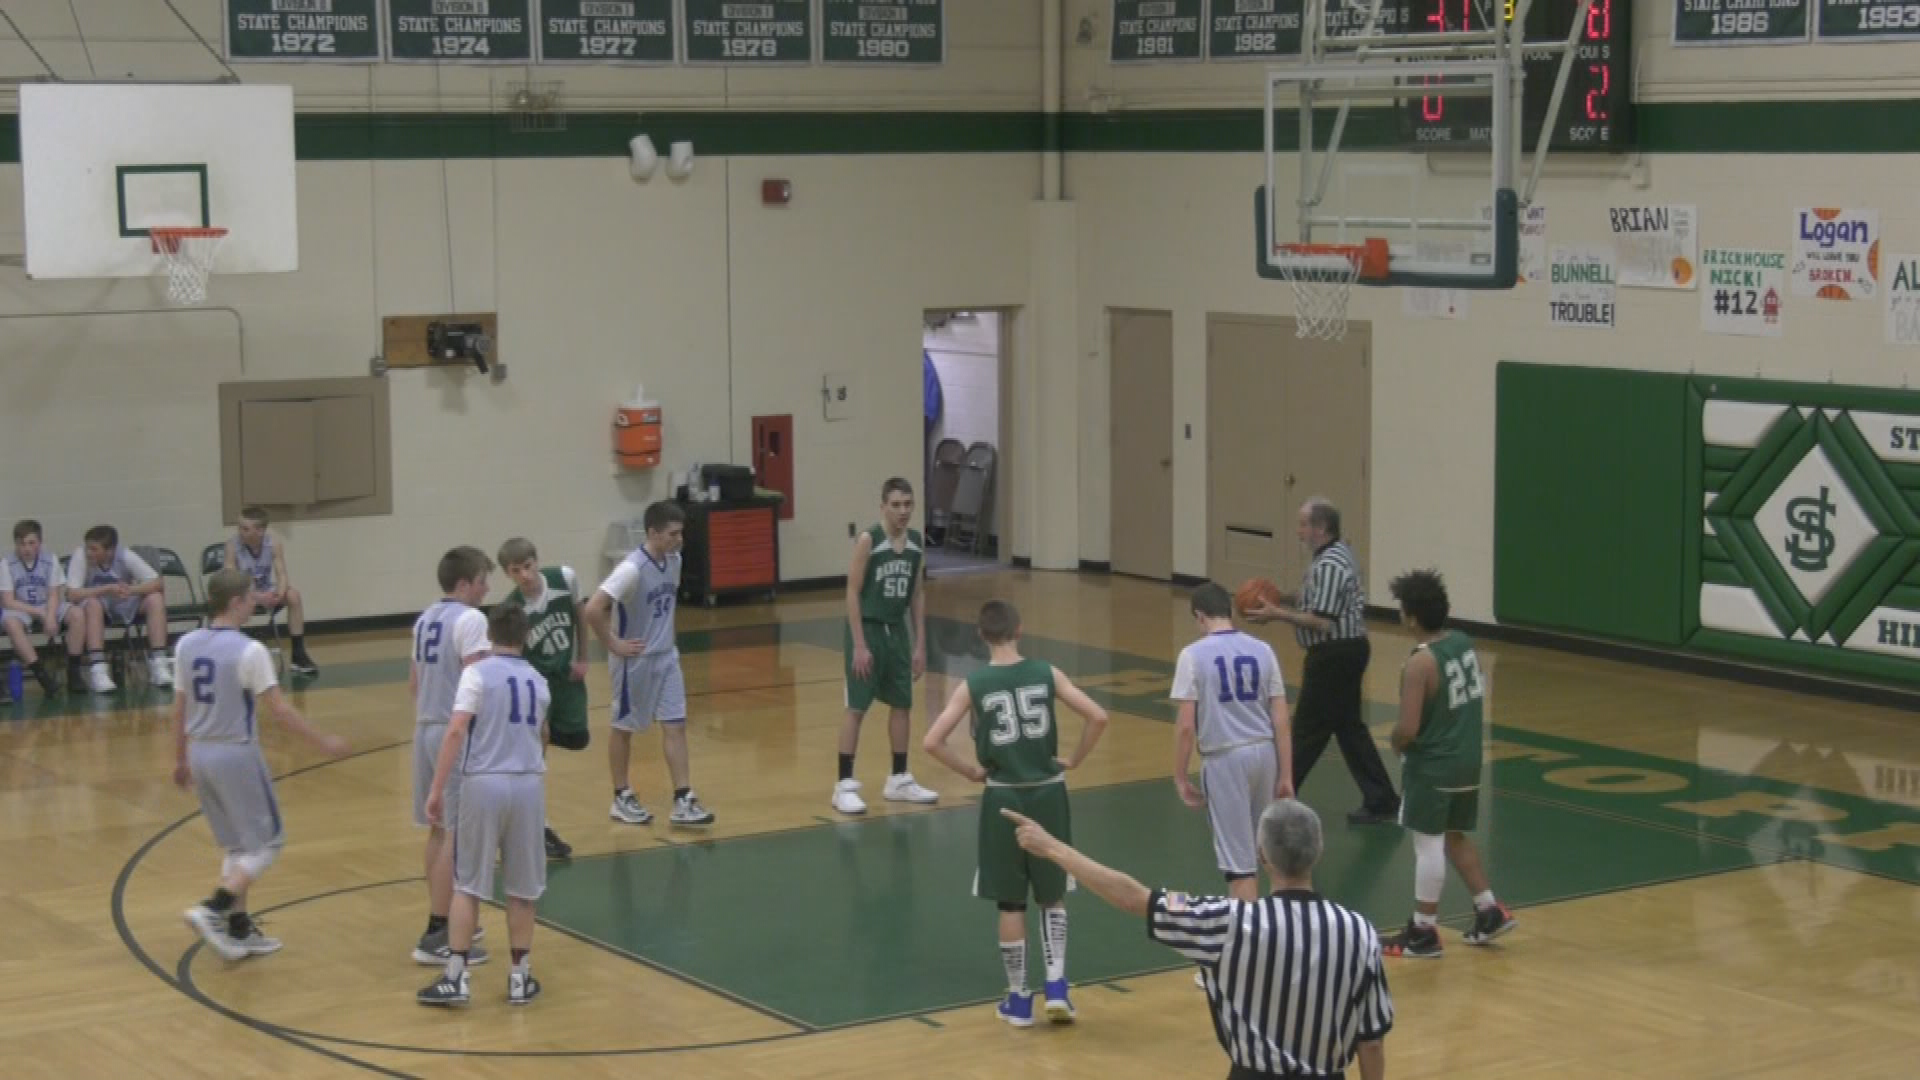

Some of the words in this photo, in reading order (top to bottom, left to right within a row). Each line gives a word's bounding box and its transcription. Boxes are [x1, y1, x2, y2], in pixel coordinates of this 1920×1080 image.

[238, 14, 281, 30] STATE
[288, 14, 368, 31] CHAMPIONS
[398, 16, 440, 33] STATE
[444, 17, 522, 34] CHAMPIONS
[549, 18, 588, 34] STATE
[594, 19, 666, 35] CHAMPIONS
[693, 20, 730, 36] STATE
[735, 20, 804, 37] CHAMPIONS
[831, 22, 865, 37] STATE
[870, 23, 936, 39] CHAMPIONS
[1119, 20, 1144, 34] STATE
[1146, 18, 1197, 33] CHAMPIONS
[1214, 15, 1242, 32] STATE
[1245, 13, 1299, 31] CHAMPIONS
[1710, 11, 1768, 35] 1986
[271, 33, 336, 53] 1972
[431, 36, 490, 55] 1974
[579, 37, 637, 55] 1977
[721, 38, 777, 57] 1978
[857, 39, 910, 58] 1980
[1137, 36, 1174, 55] 1981
[1235, 33, 1277, 53] 1982
[1416, 128, 1450, 141] SCORE
[1468, 128, 1493, 141] MAT
[1609, 207, 1669, 233] BRIAN
[1800, 212, 1868, 248] Logan
[1703, 249, 1785, 270] BRICKHOUSE
[1551, 263, 1615, 284] BUNNELL
[1710, 269, 1762, 287] NICK!
[1714, 289, 1758, 316] #12
[1549, 301, 1615, 327] TROUBLE!
[883, 577, 909, 598] 50
[416, 621, 442, 665] 12
[192, 657, 216, 705] 2
[1213, 655, 1259, 702] 10
[1445, 649, 1486, 710] 23
[507, 675, 538, 727] 11
[981, 684, 1050, 746] 35
